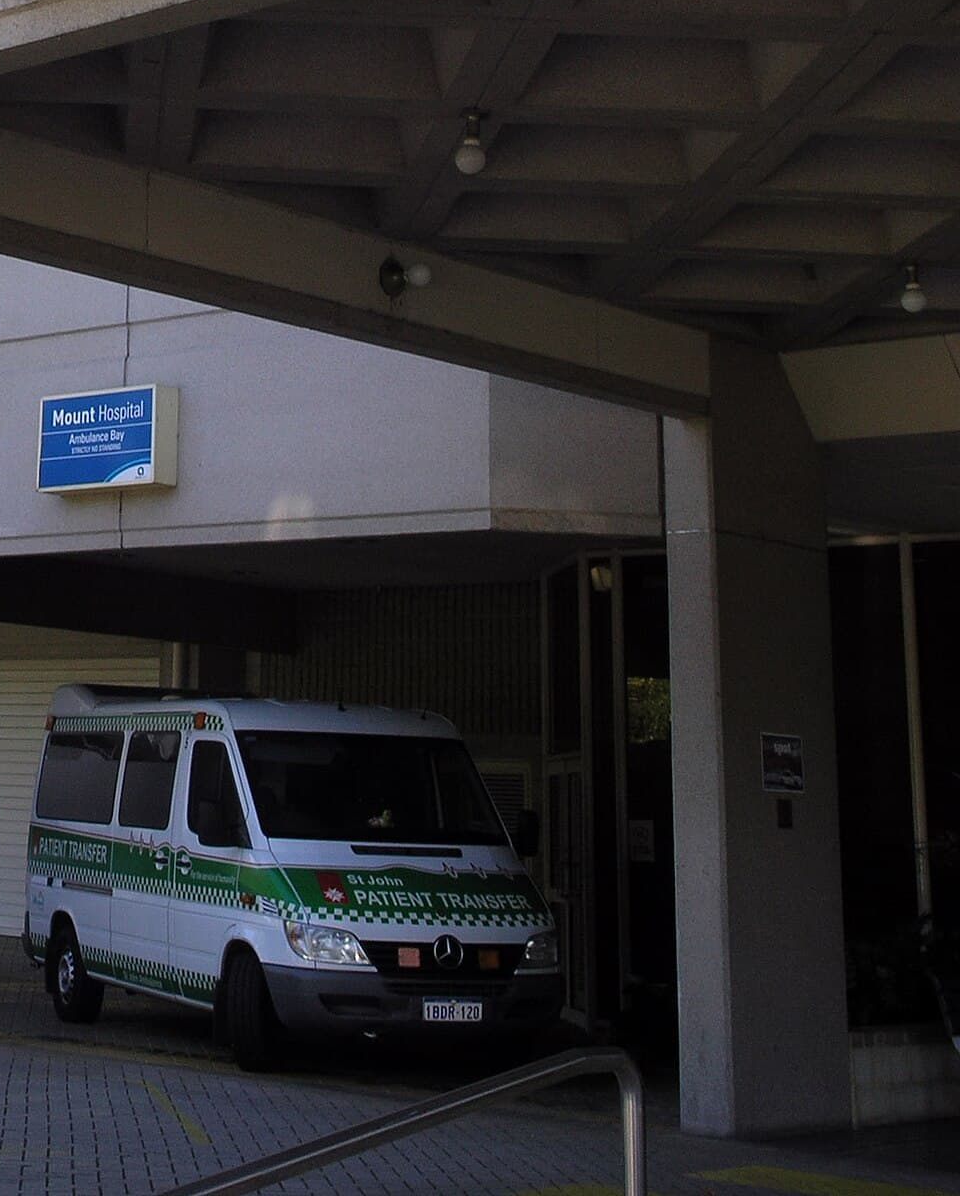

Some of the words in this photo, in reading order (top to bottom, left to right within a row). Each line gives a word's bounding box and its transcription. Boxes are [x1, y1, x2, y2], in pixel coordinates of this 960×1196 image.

[52, 407, 96, 427] Mount
[98, 400, 144, 423] Hospital
[69, 432, 109, 445] Ambulance
[110, 429, 125, 442] Bay
[38, 836, 68, 858] PATIENT
[68, 840, 107, 865] TRANSFER
[346, 874, 365, 885] St
[367, 874, 404, 887] John
[353, 889, 434, 908] PATIENT
[436, 892, 531, 910] TRANSFER
